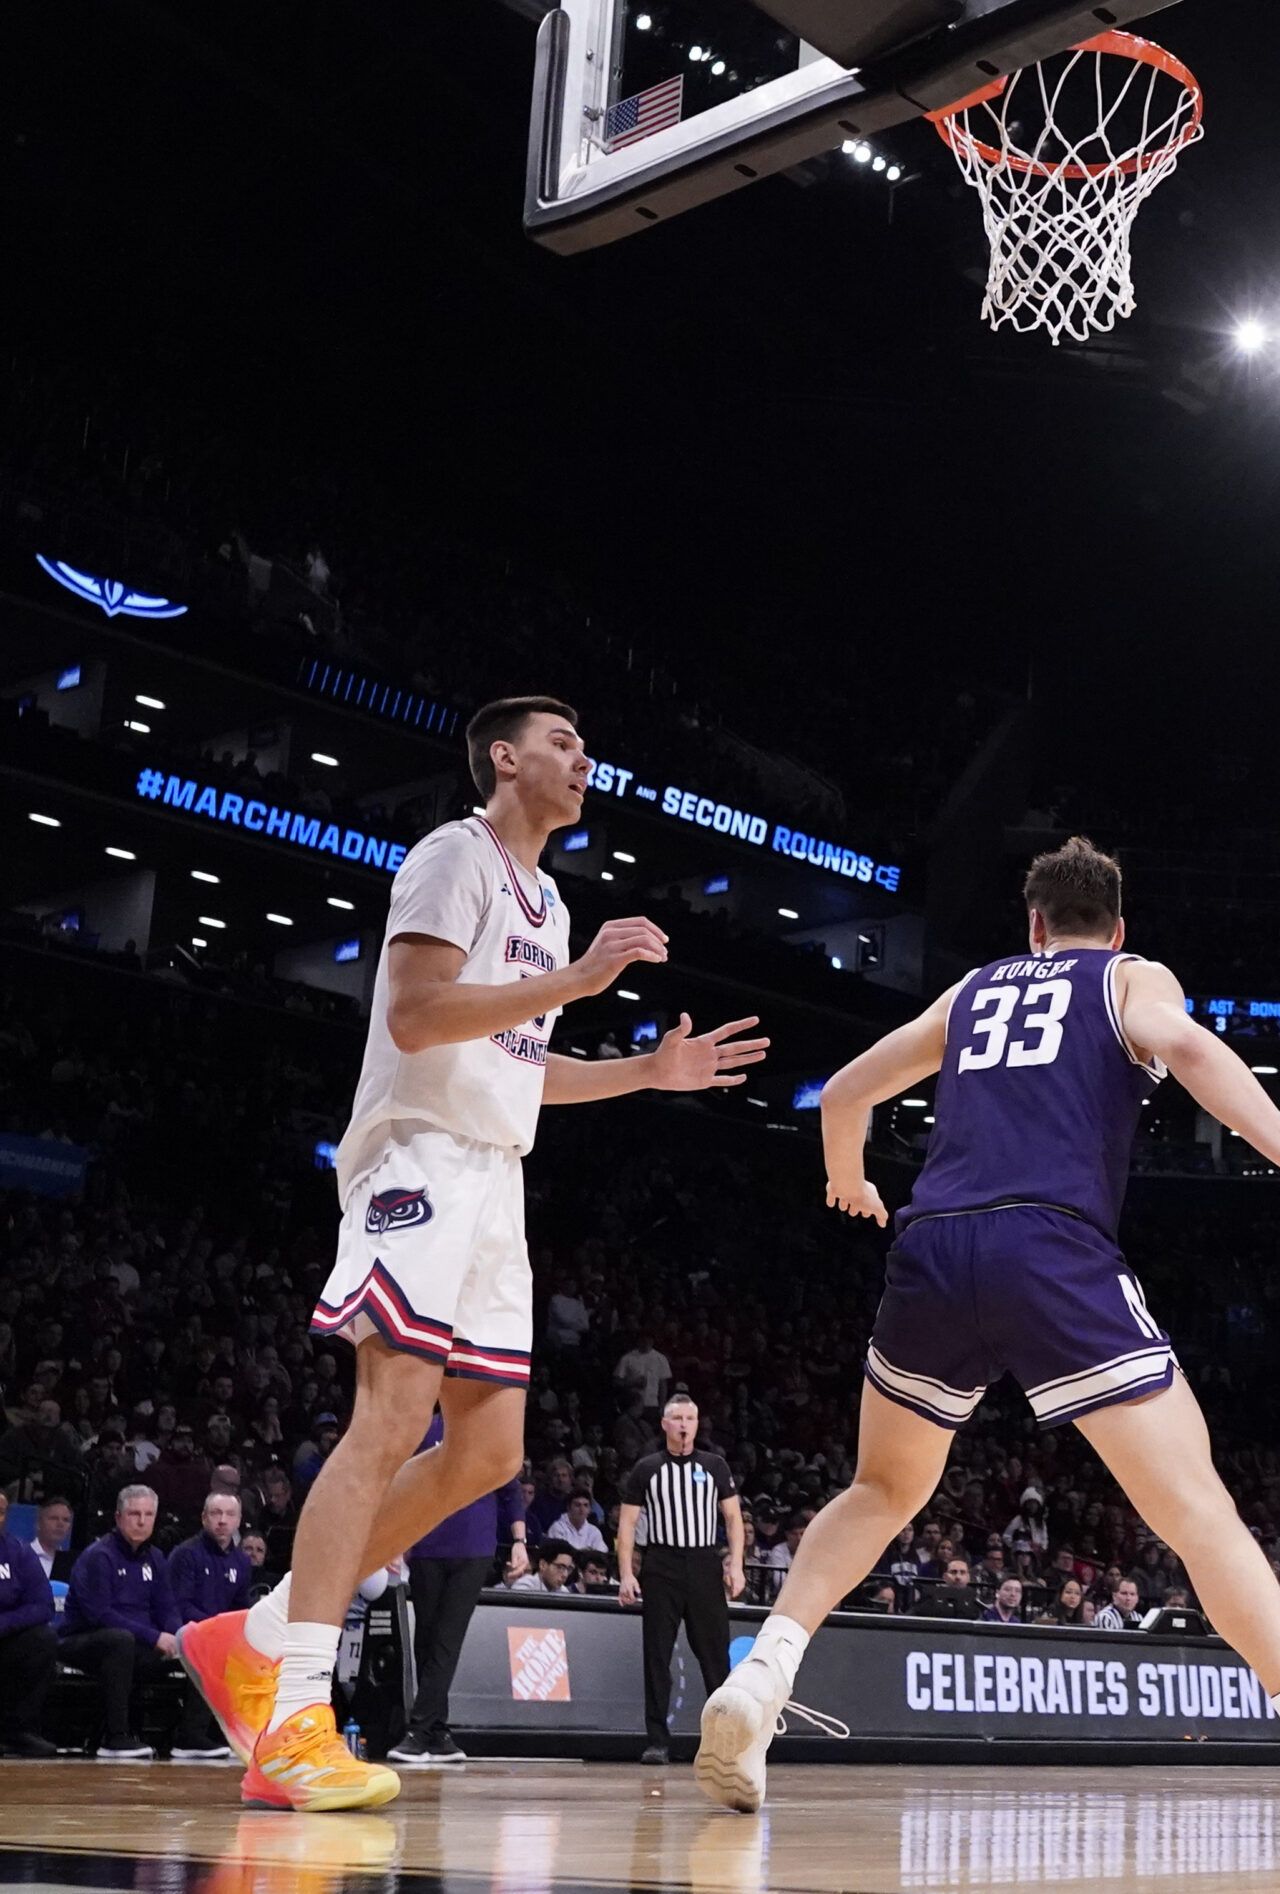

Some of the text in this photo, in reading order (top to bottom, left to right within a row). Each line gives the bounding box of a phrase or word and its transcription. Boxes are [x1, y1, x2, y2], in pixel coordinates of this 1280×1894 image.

[635, 784, 657, 802] AND
[661, 785, 769, 846] SECOND
[771, 824, 875, 884] ROUNDS
[989, 958, 1080, 982] HUNGER
[957, 978, 1073, 1076] 33
[1208, 1000, 1235, 1015] AST
[1215, 1016, 1227, 1032] 3
[512, 1628, 566, 1700] HOME
[906, 1651, 1129, 1716] CELEBRATES
